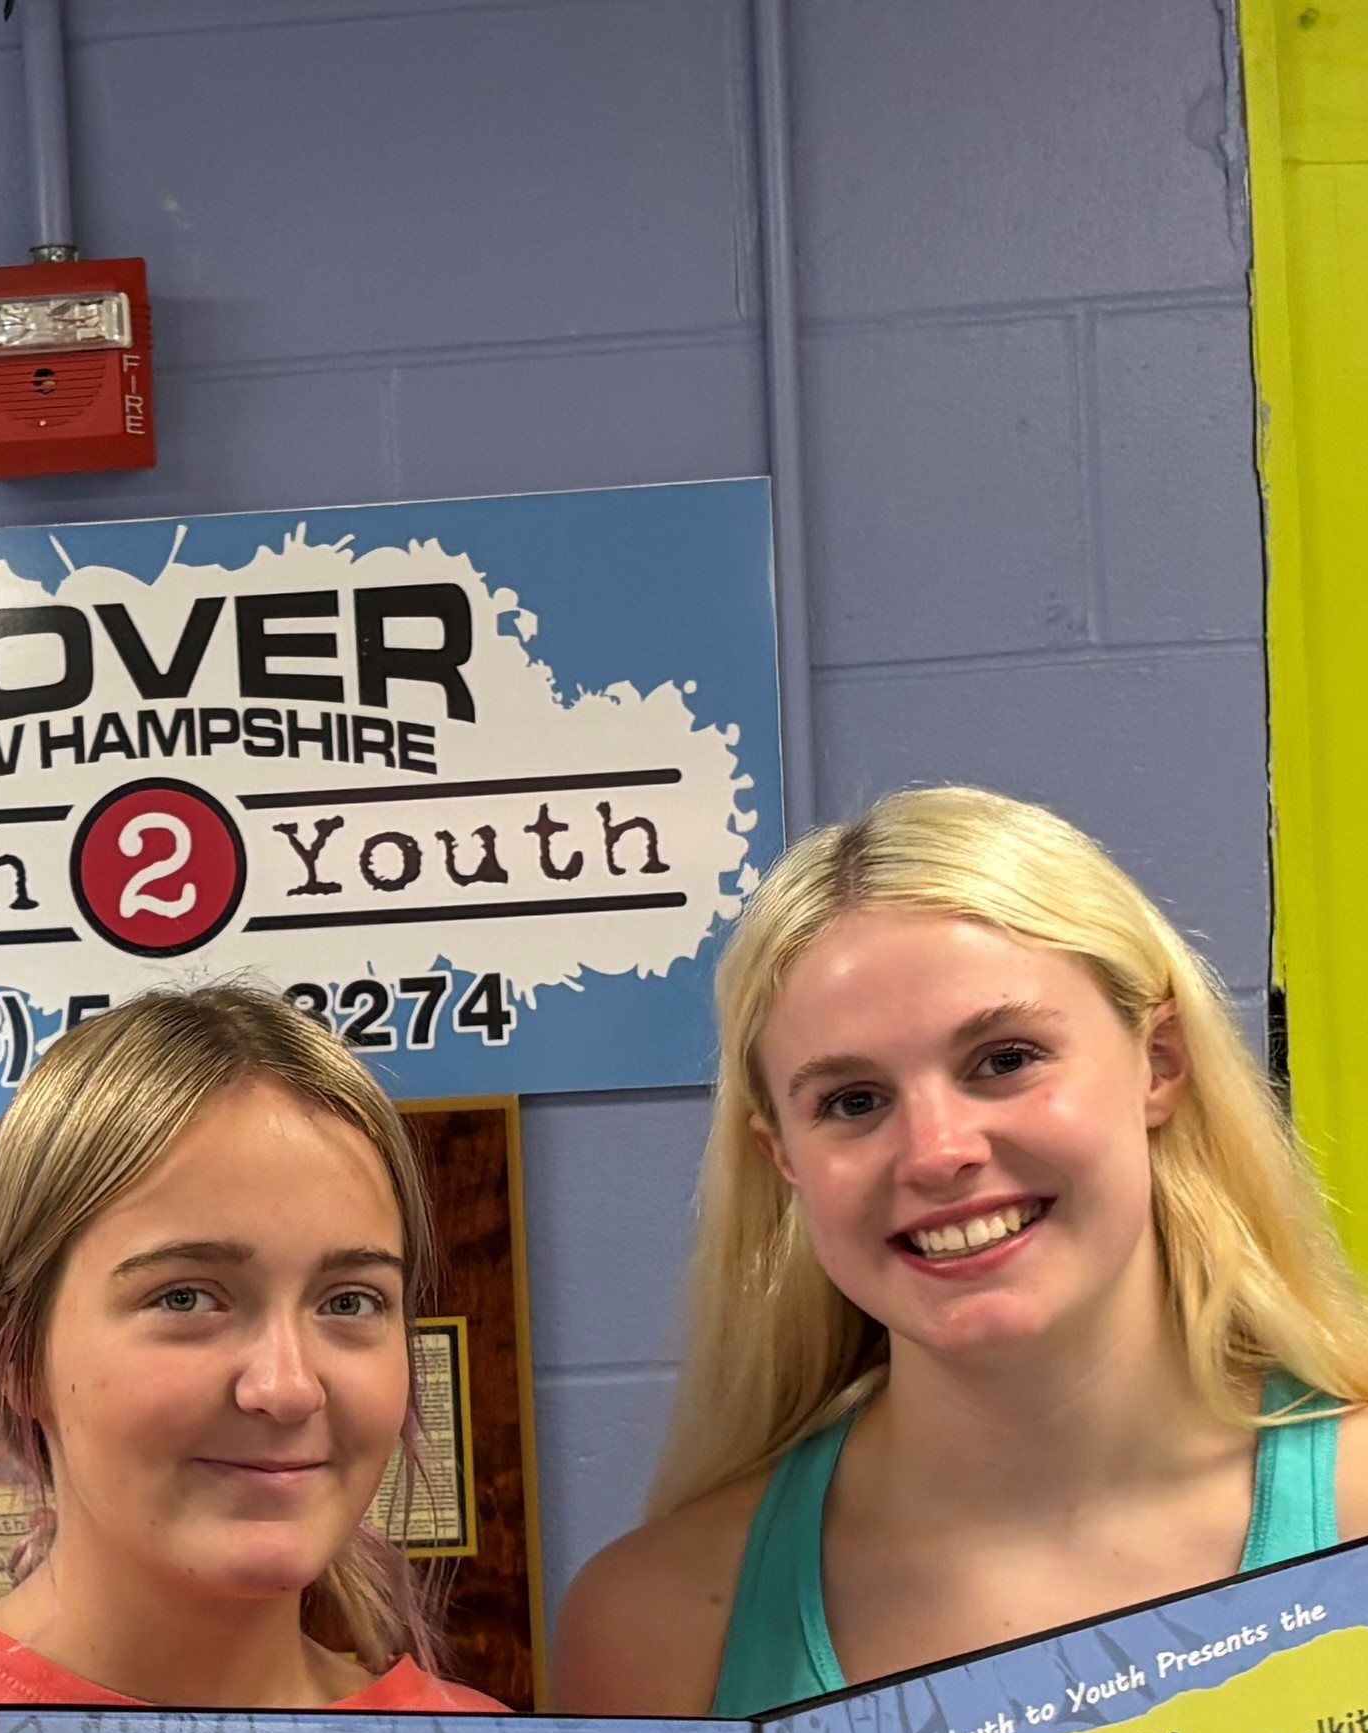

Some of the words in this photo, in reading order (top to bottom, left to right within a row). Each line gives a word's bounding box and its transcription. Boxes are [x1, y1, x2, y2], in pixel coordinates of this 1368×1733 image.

[122, 354, 145, 435] FIRE
[38, 707, 439, 774] HAMPSHIRE
[116, 812, 198, 919] 2
[274, 801, 673, 897] Youth
[1025, 1701, 1055, 1726] to
[1065, 1665, 1145, 1712] Youth
[1157, 1622, 1269, 1678] Presents
[1281, 1601, 1327, 1632] the
